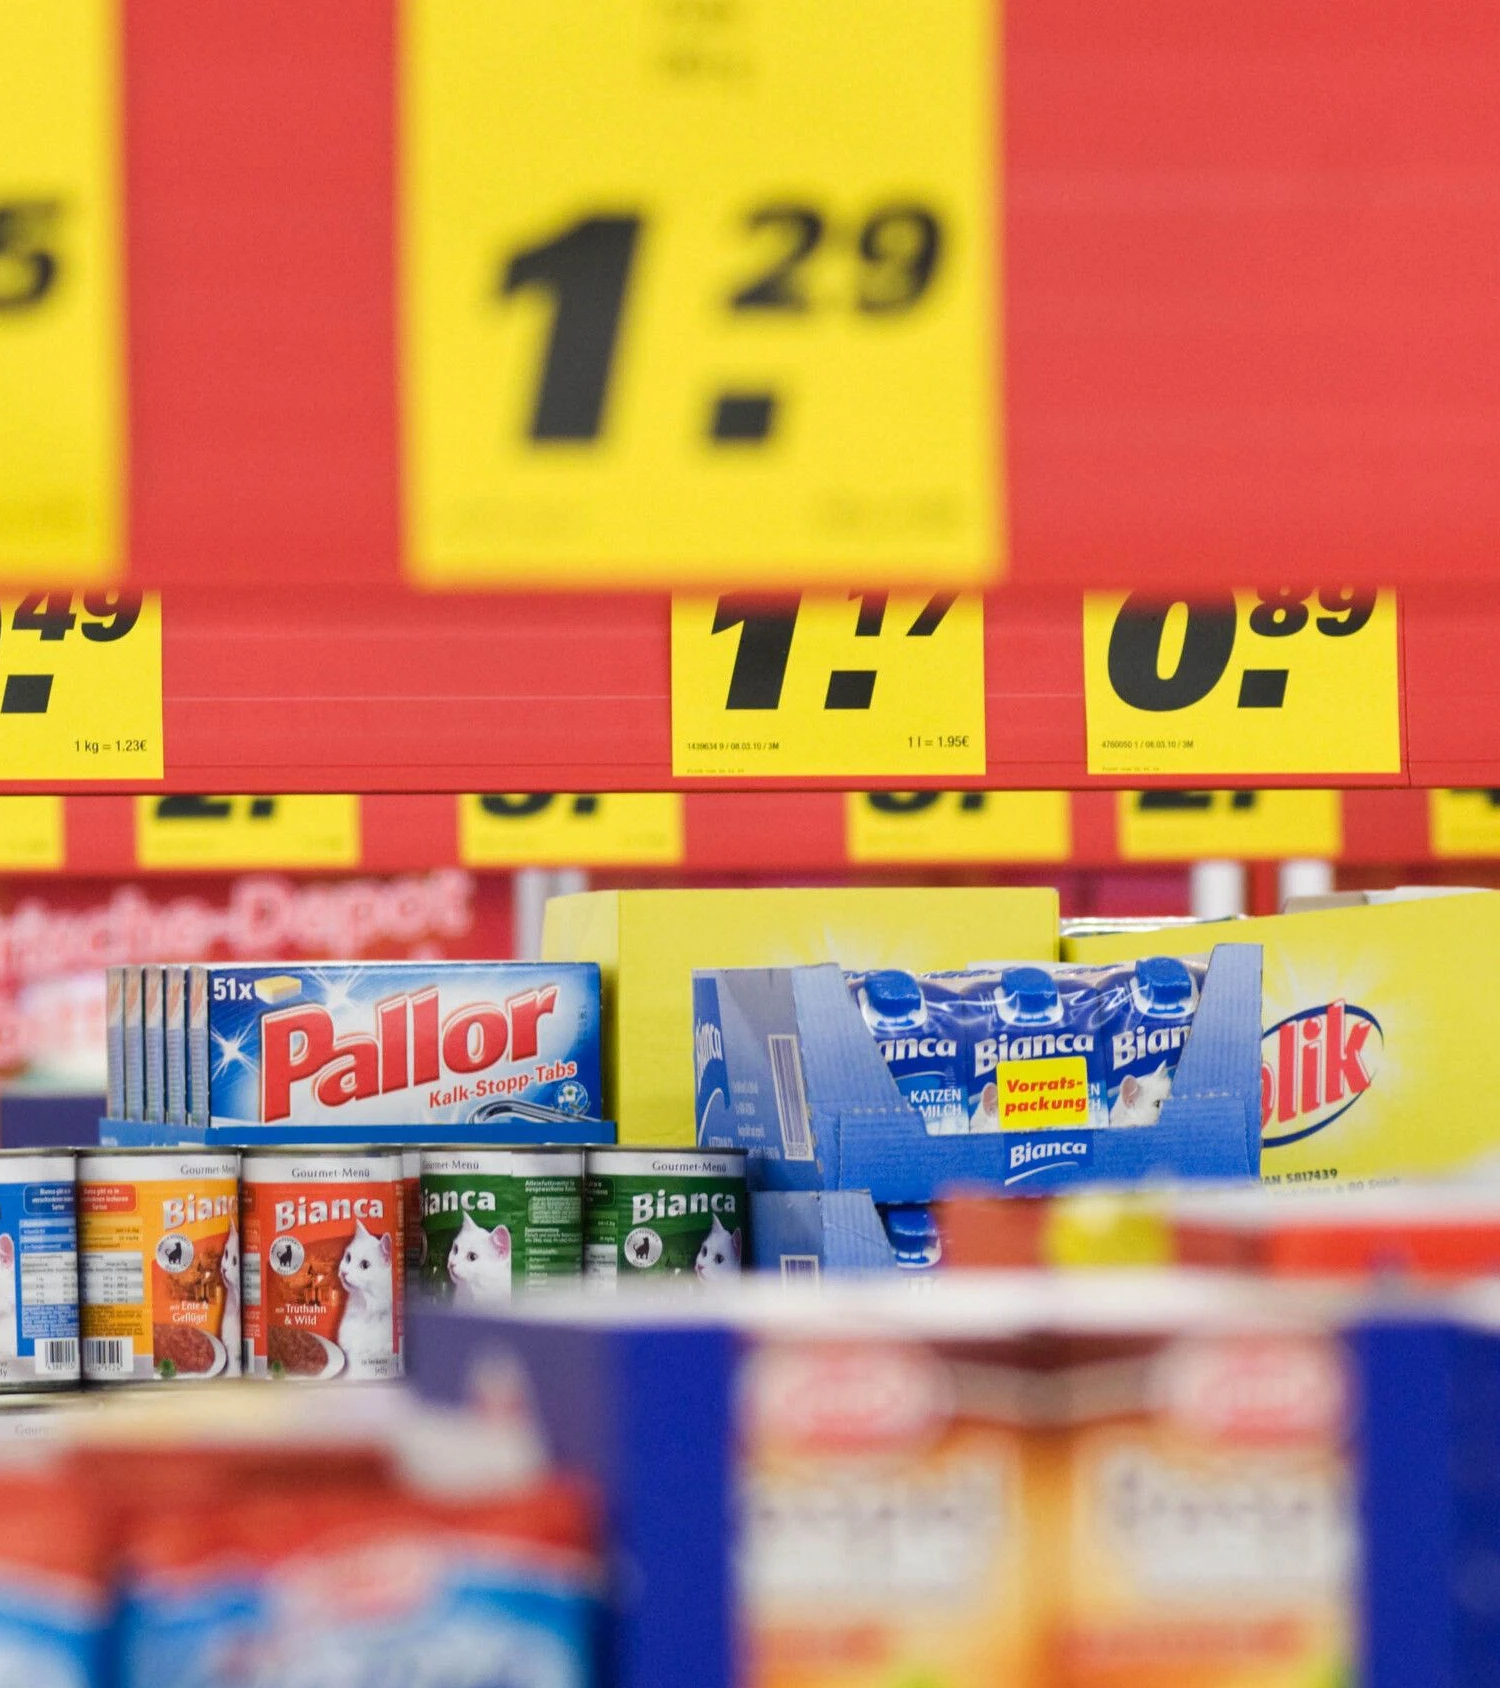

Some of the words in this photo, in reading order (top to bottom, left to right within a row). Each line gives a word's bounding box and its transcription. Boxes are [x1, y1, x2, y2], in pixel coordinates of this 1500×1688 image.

[490, 204, 946, 448] 1.29
[75, 740, 80, 752] 1
[85, 739, 99, 754] kg
[115, 740, 147, 752] 1.23€
[908, 736, 913, 748] 1
[938, 735, 970, 748] 1.95€
[213, 977, 252, 1000] 51x
[260, 984, 560, 1123] Pallor
[974, 1033, 1094, 1077] Bianca
[428, 1060, 579, 1109] Kalk-Stopp-Tabs
[1006, 1077, 1084, 1093] Vorrats-
[911, 1088, 962, 1104] KATZEN
[919, 1104, 962, 1118] MILCH
[1004, 1097, 1087, 1117] packung
[1009, 1141, 1088, 1169] Bianca
[291, 1167, 370, 1179] Gourmet-Menü
[652, 1162, 727, 1173] Gourmet-Menü
[1286, 1168, 1339, 1185] 5817439
[275, 1196, 384, 1233] Bianca
[632, 1189, 736, 1225] Bianca
[181, 1301, 200, 1311] Ente
[286, 1303, 327, 1314] Truthahn
[172, 1312, 208, 1324] Geflügel
[284, 1315, 292, 1326] &
[294, 1314, 317, 1325] Wild
